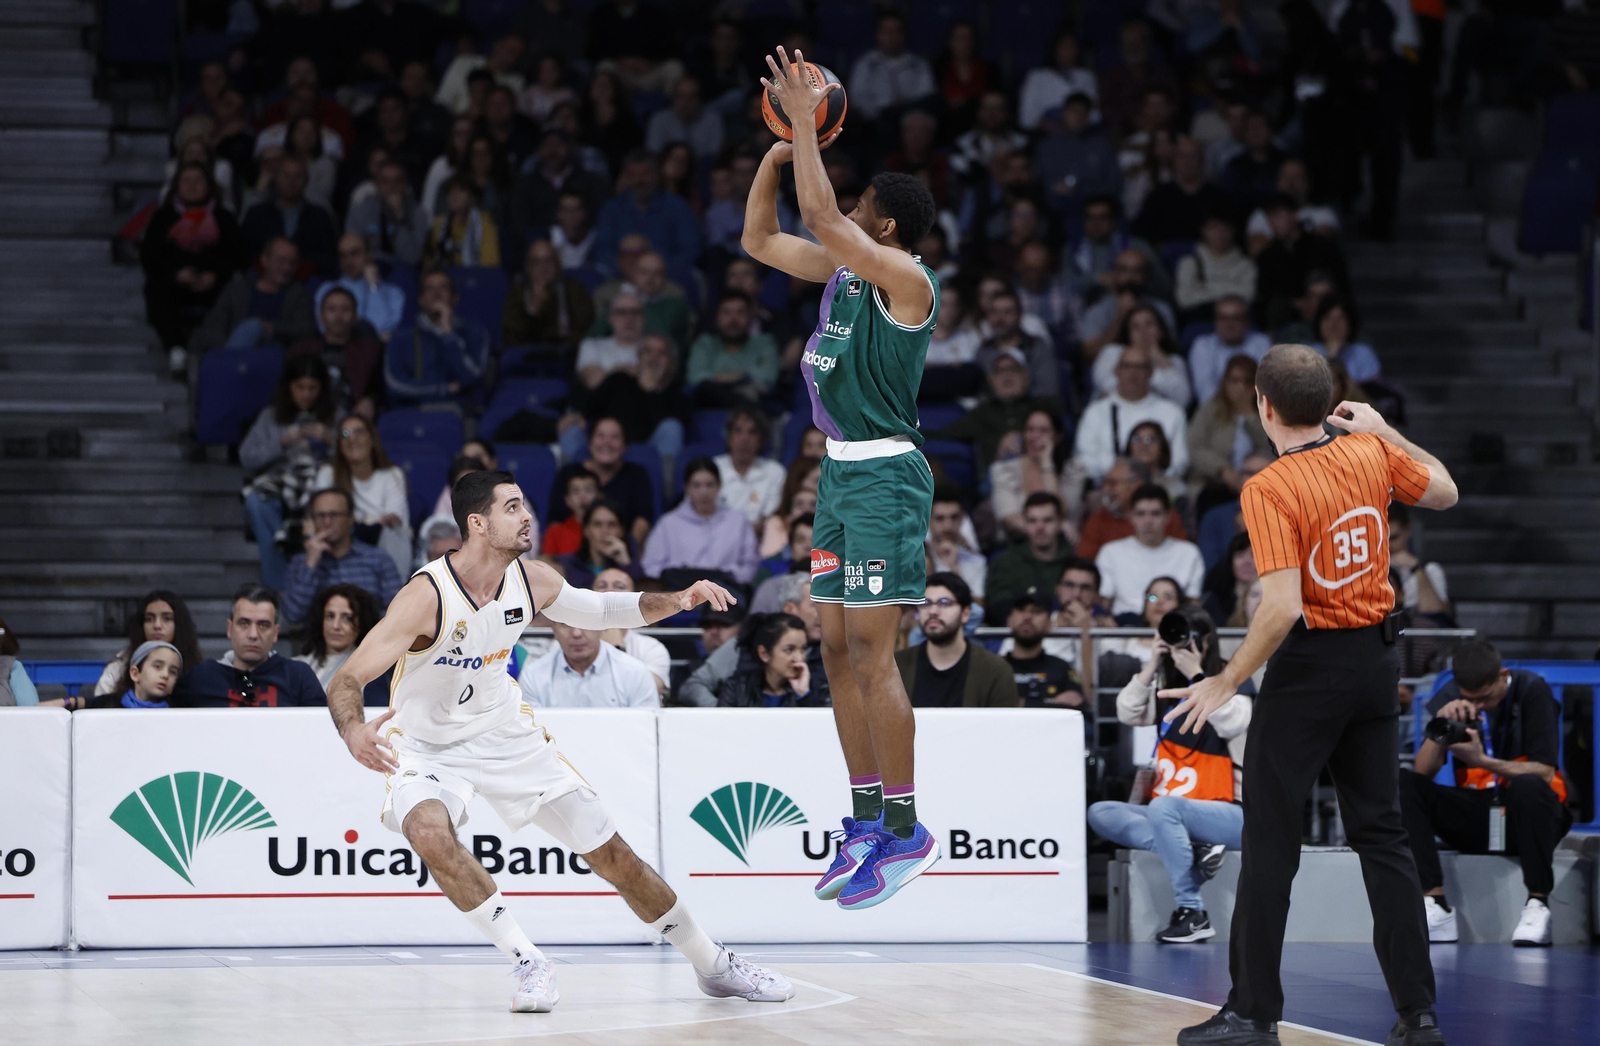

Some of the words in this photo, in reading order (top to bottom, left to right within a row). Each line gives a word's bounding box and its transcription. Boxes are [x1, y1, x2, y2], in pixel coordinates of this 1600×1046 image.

[1333, 526, 1369, 568] 35
[845, 576, 865, 591] aga
[1153, 758, 1198, 797] 22
[268, 829, 430, 888] Unicaj
[472, 834, 593, 875] Banc
[949, 829, 1060, 860] Banco
